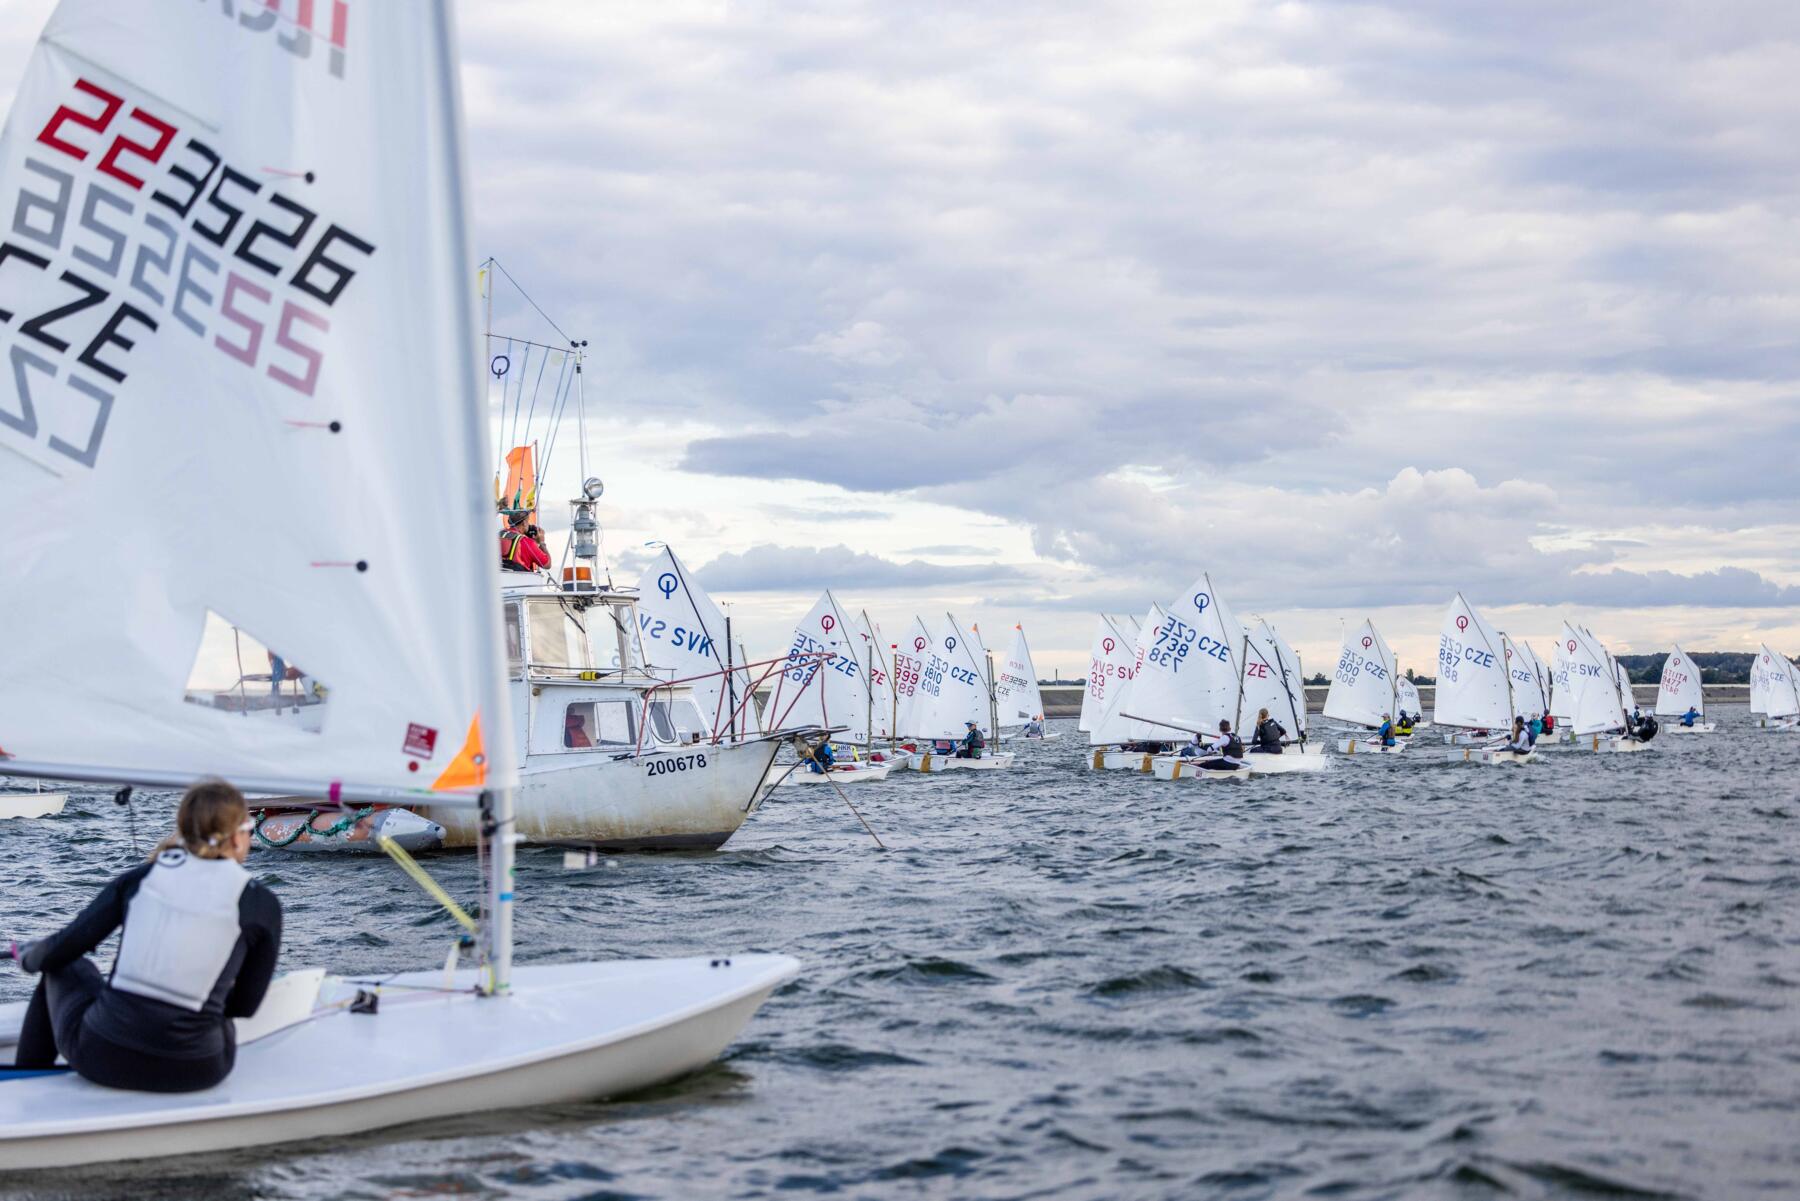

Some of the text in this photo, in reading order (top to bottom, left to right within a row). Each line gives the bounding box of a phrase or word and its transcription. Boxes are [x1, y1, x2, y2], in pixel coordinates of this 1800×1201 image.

[37, 77, 376, 307] 223526
[671, 627, 715, 657] SVK
[1156, 632, 1189, 658] 738
[1198, 636, 1231, 662] CZE
[1439, 648, 1460, 667] 887
[1465, 647, 1495, 669] CZE
[951, 666, 977, 686] CZE
[1339, 659, 1359, 677] 900
[1365, 661, 1389, 680] CZE
[1512, 669, 1531, 682] CZE
[1579, 663, 1601, 678] SVK
[1091, 672, 1105, 687] 33
[646, 753, 707, 776] 200678
